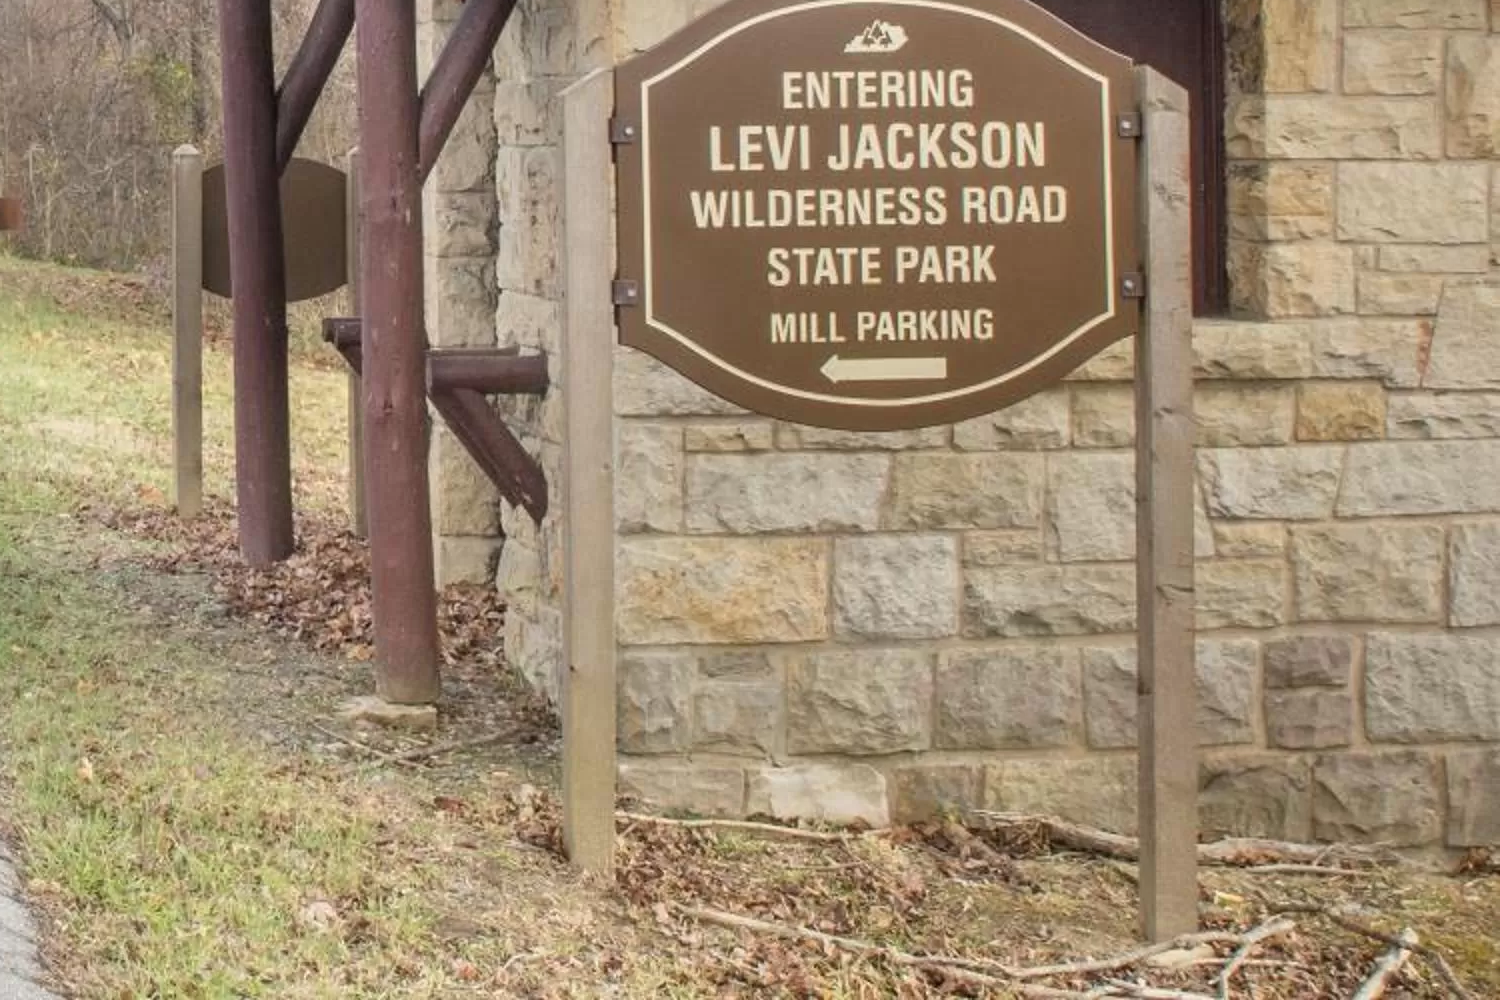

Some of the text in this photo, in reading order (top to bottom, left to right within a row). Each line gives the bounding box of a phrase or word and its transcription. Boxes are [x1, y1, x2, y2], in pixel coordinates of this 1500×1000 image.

[782, 69, 975, 109] ENTERING
[710, 121, 1045, 172] LEVI JACKSON
[690, 185, 1067, 229] WILDERNESS ROAD
[767, 245, 997, 287] STATE PARK
[771, 308, 994, 343] MILL PARKING
